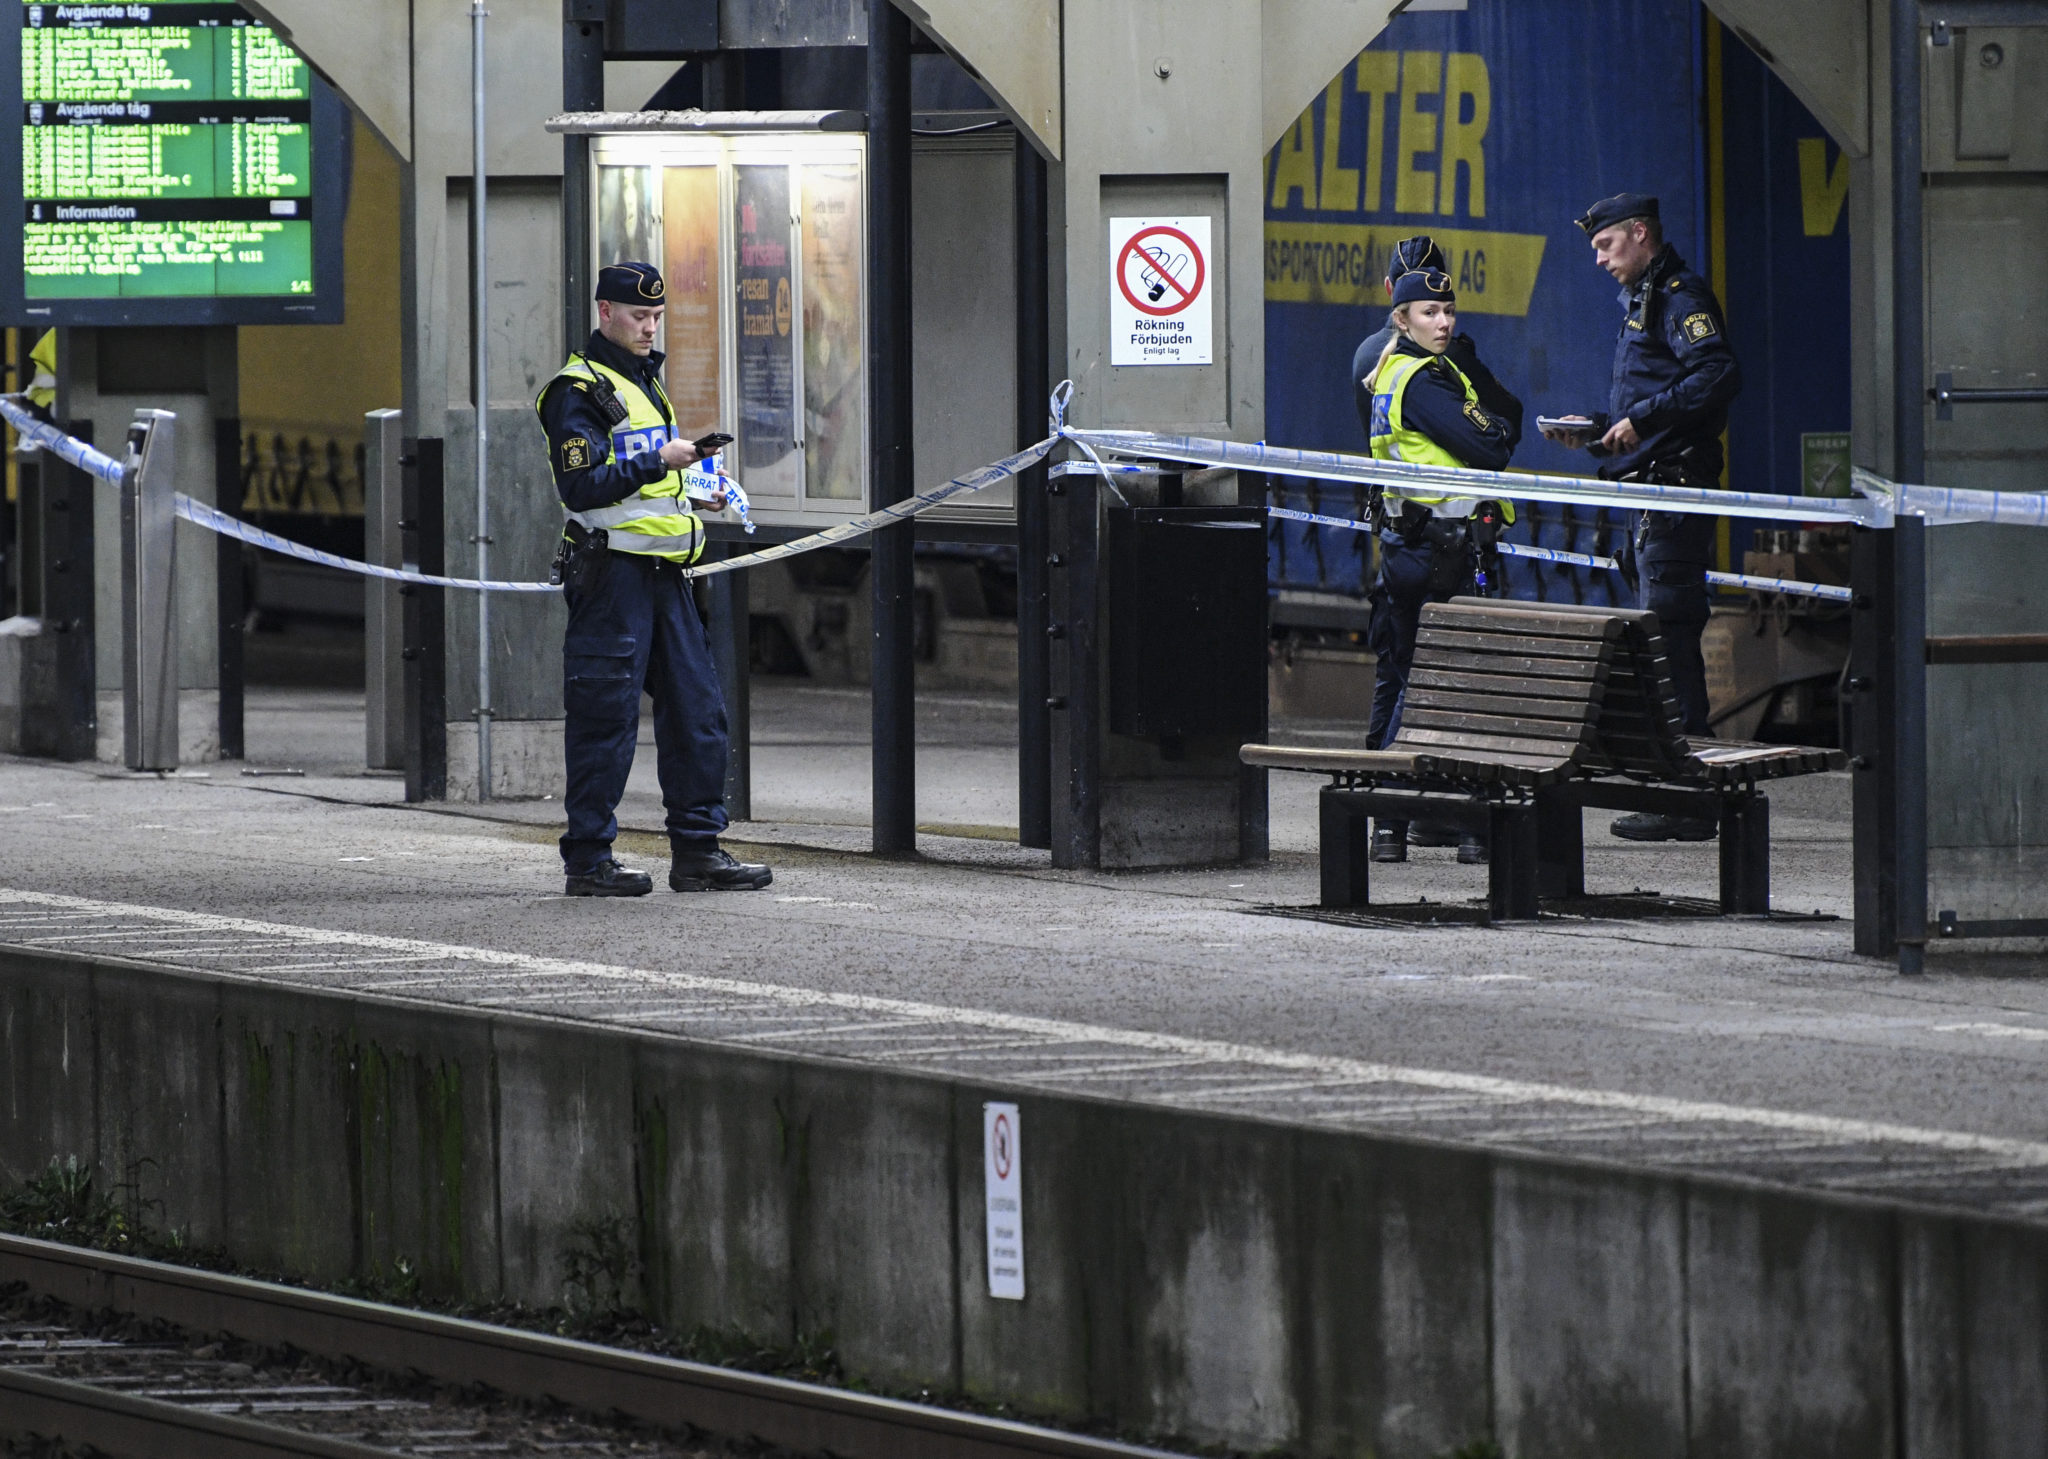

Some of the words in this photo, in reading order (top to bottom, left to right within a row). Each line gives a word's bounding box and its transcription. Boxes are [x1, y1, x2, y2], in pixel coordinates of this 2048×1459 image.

[56, 5, 125, 21] Avgående
[127, 4, 150, 21] tåg
[56, 102, 125, 118] Avgående
[127, 101, 150, 118] tåg
[1263, 51, 1490, 218] ALTER
[56, 205, 136, 219] Information
[1459, 249, 1487, 294] AG
[742, 278, 769, 300] resan
[1135, 319, 1185, 332] Rökning
[1685, 314, 1707, 326] POLIS
[1131, 334, 1193, 347] Förbjuden
[1144, 347, 1166, 355] Enligt
[1168, 347, 1180, 355] lag
[563, 439, 586, 450] POLIS
